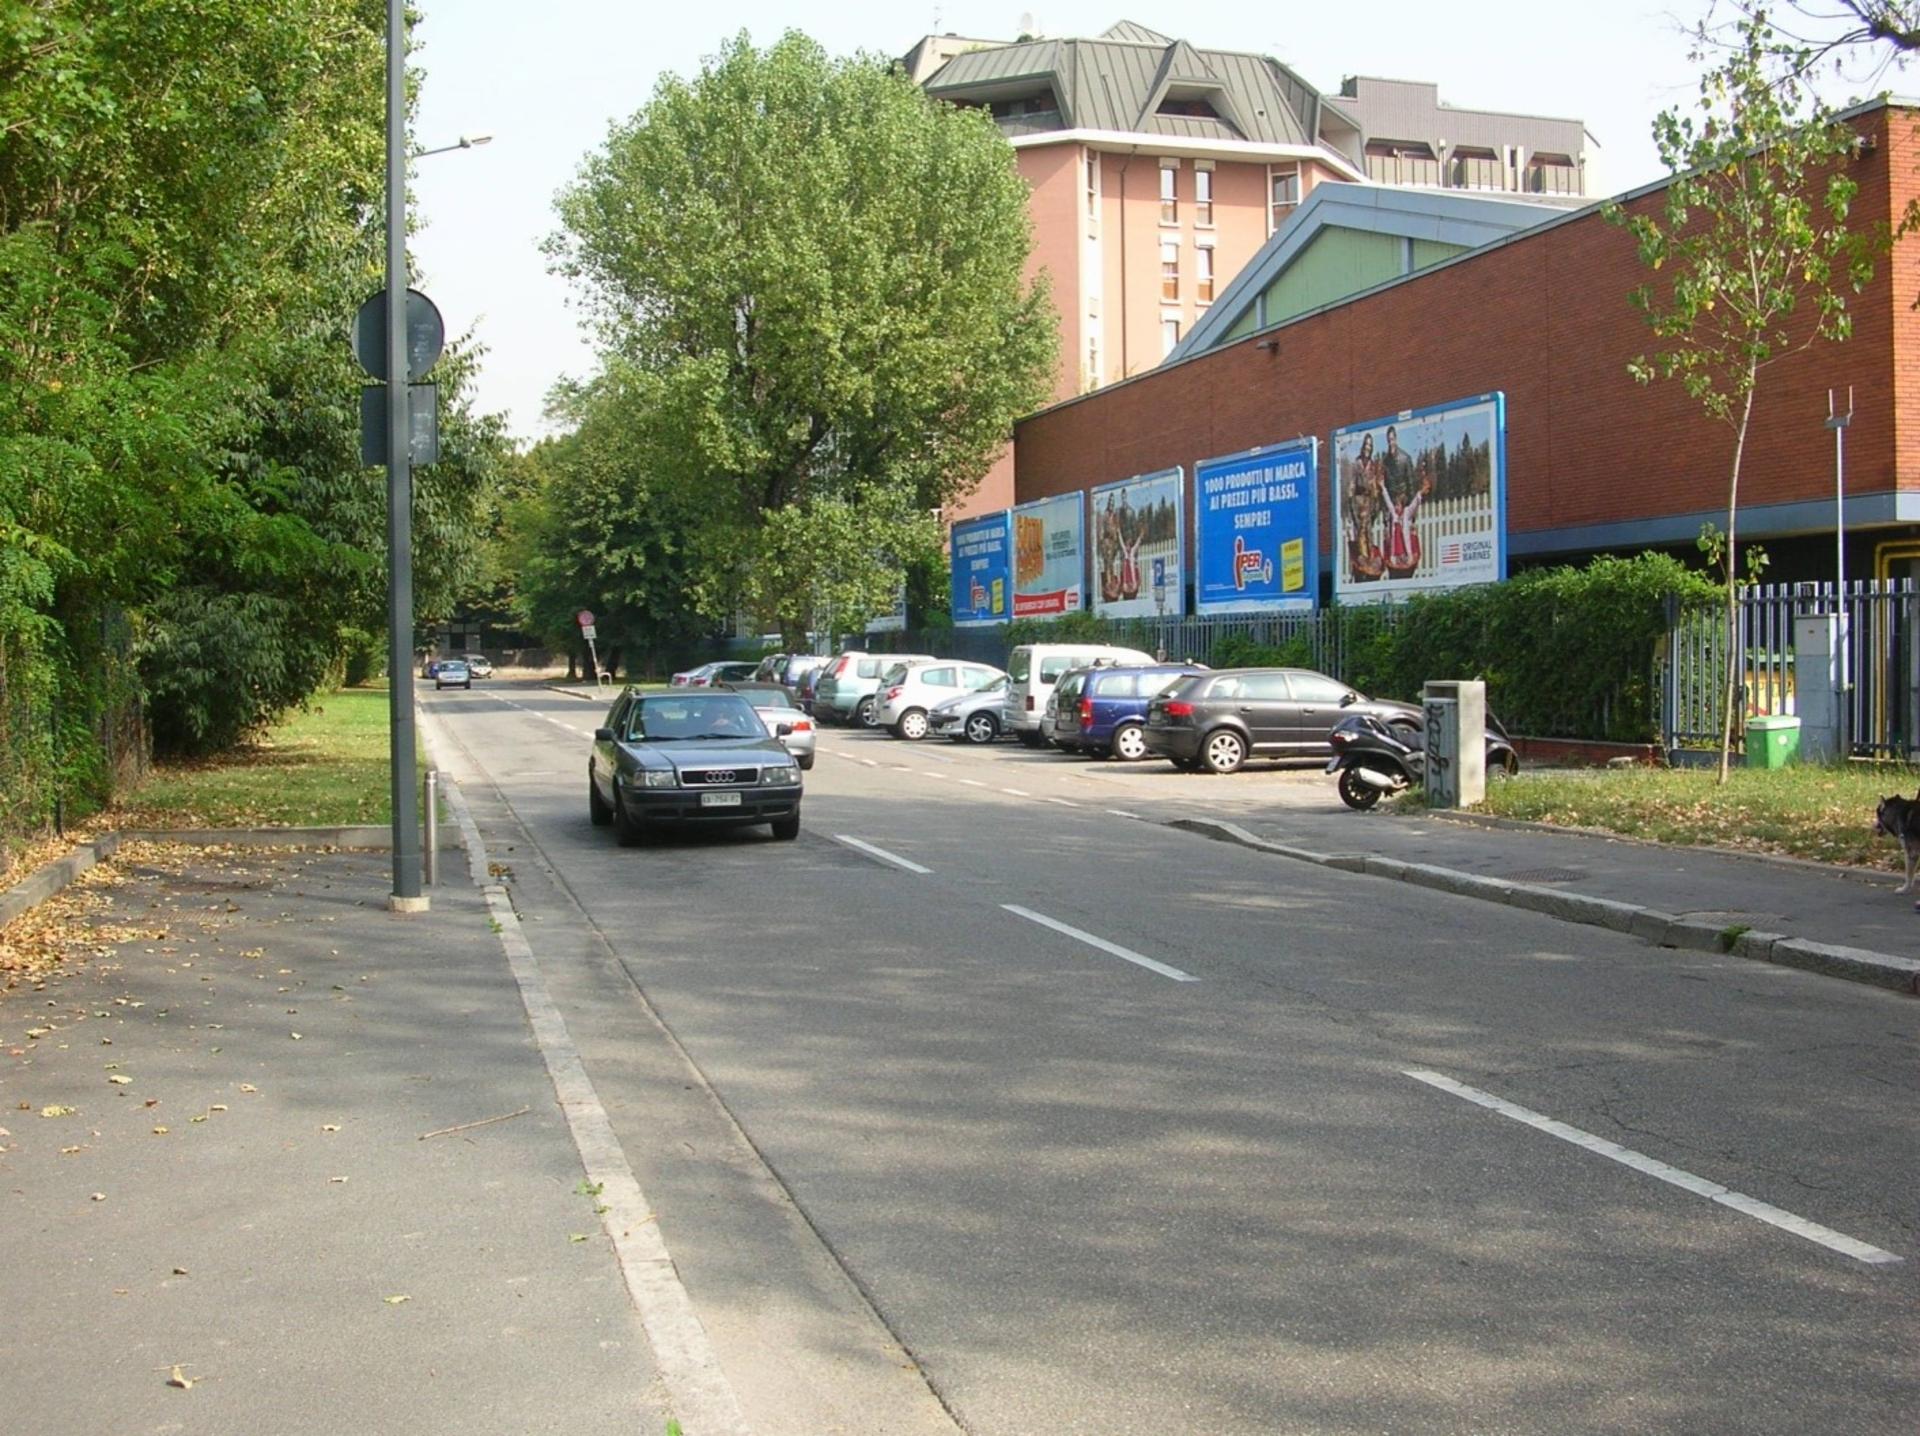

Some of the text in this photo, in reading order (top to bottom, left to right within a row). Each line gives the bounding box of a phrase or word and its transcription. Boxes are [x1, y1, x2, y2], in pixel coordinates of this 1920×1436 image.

[1205, 462, 1306, 494] 1000 PRODOTTI DI MARCA
[1210, 496, 1219, 510] AI
[1221, 490, 1249, 509] PREZZI
[1269, 483, 1299, 502] BASSI.
[1234, 510, 1271, 529] SEMPRE!
[1462, 541, 1492, 552] ORIGINAL
[1463, 551, 1490, 560] MARINES
